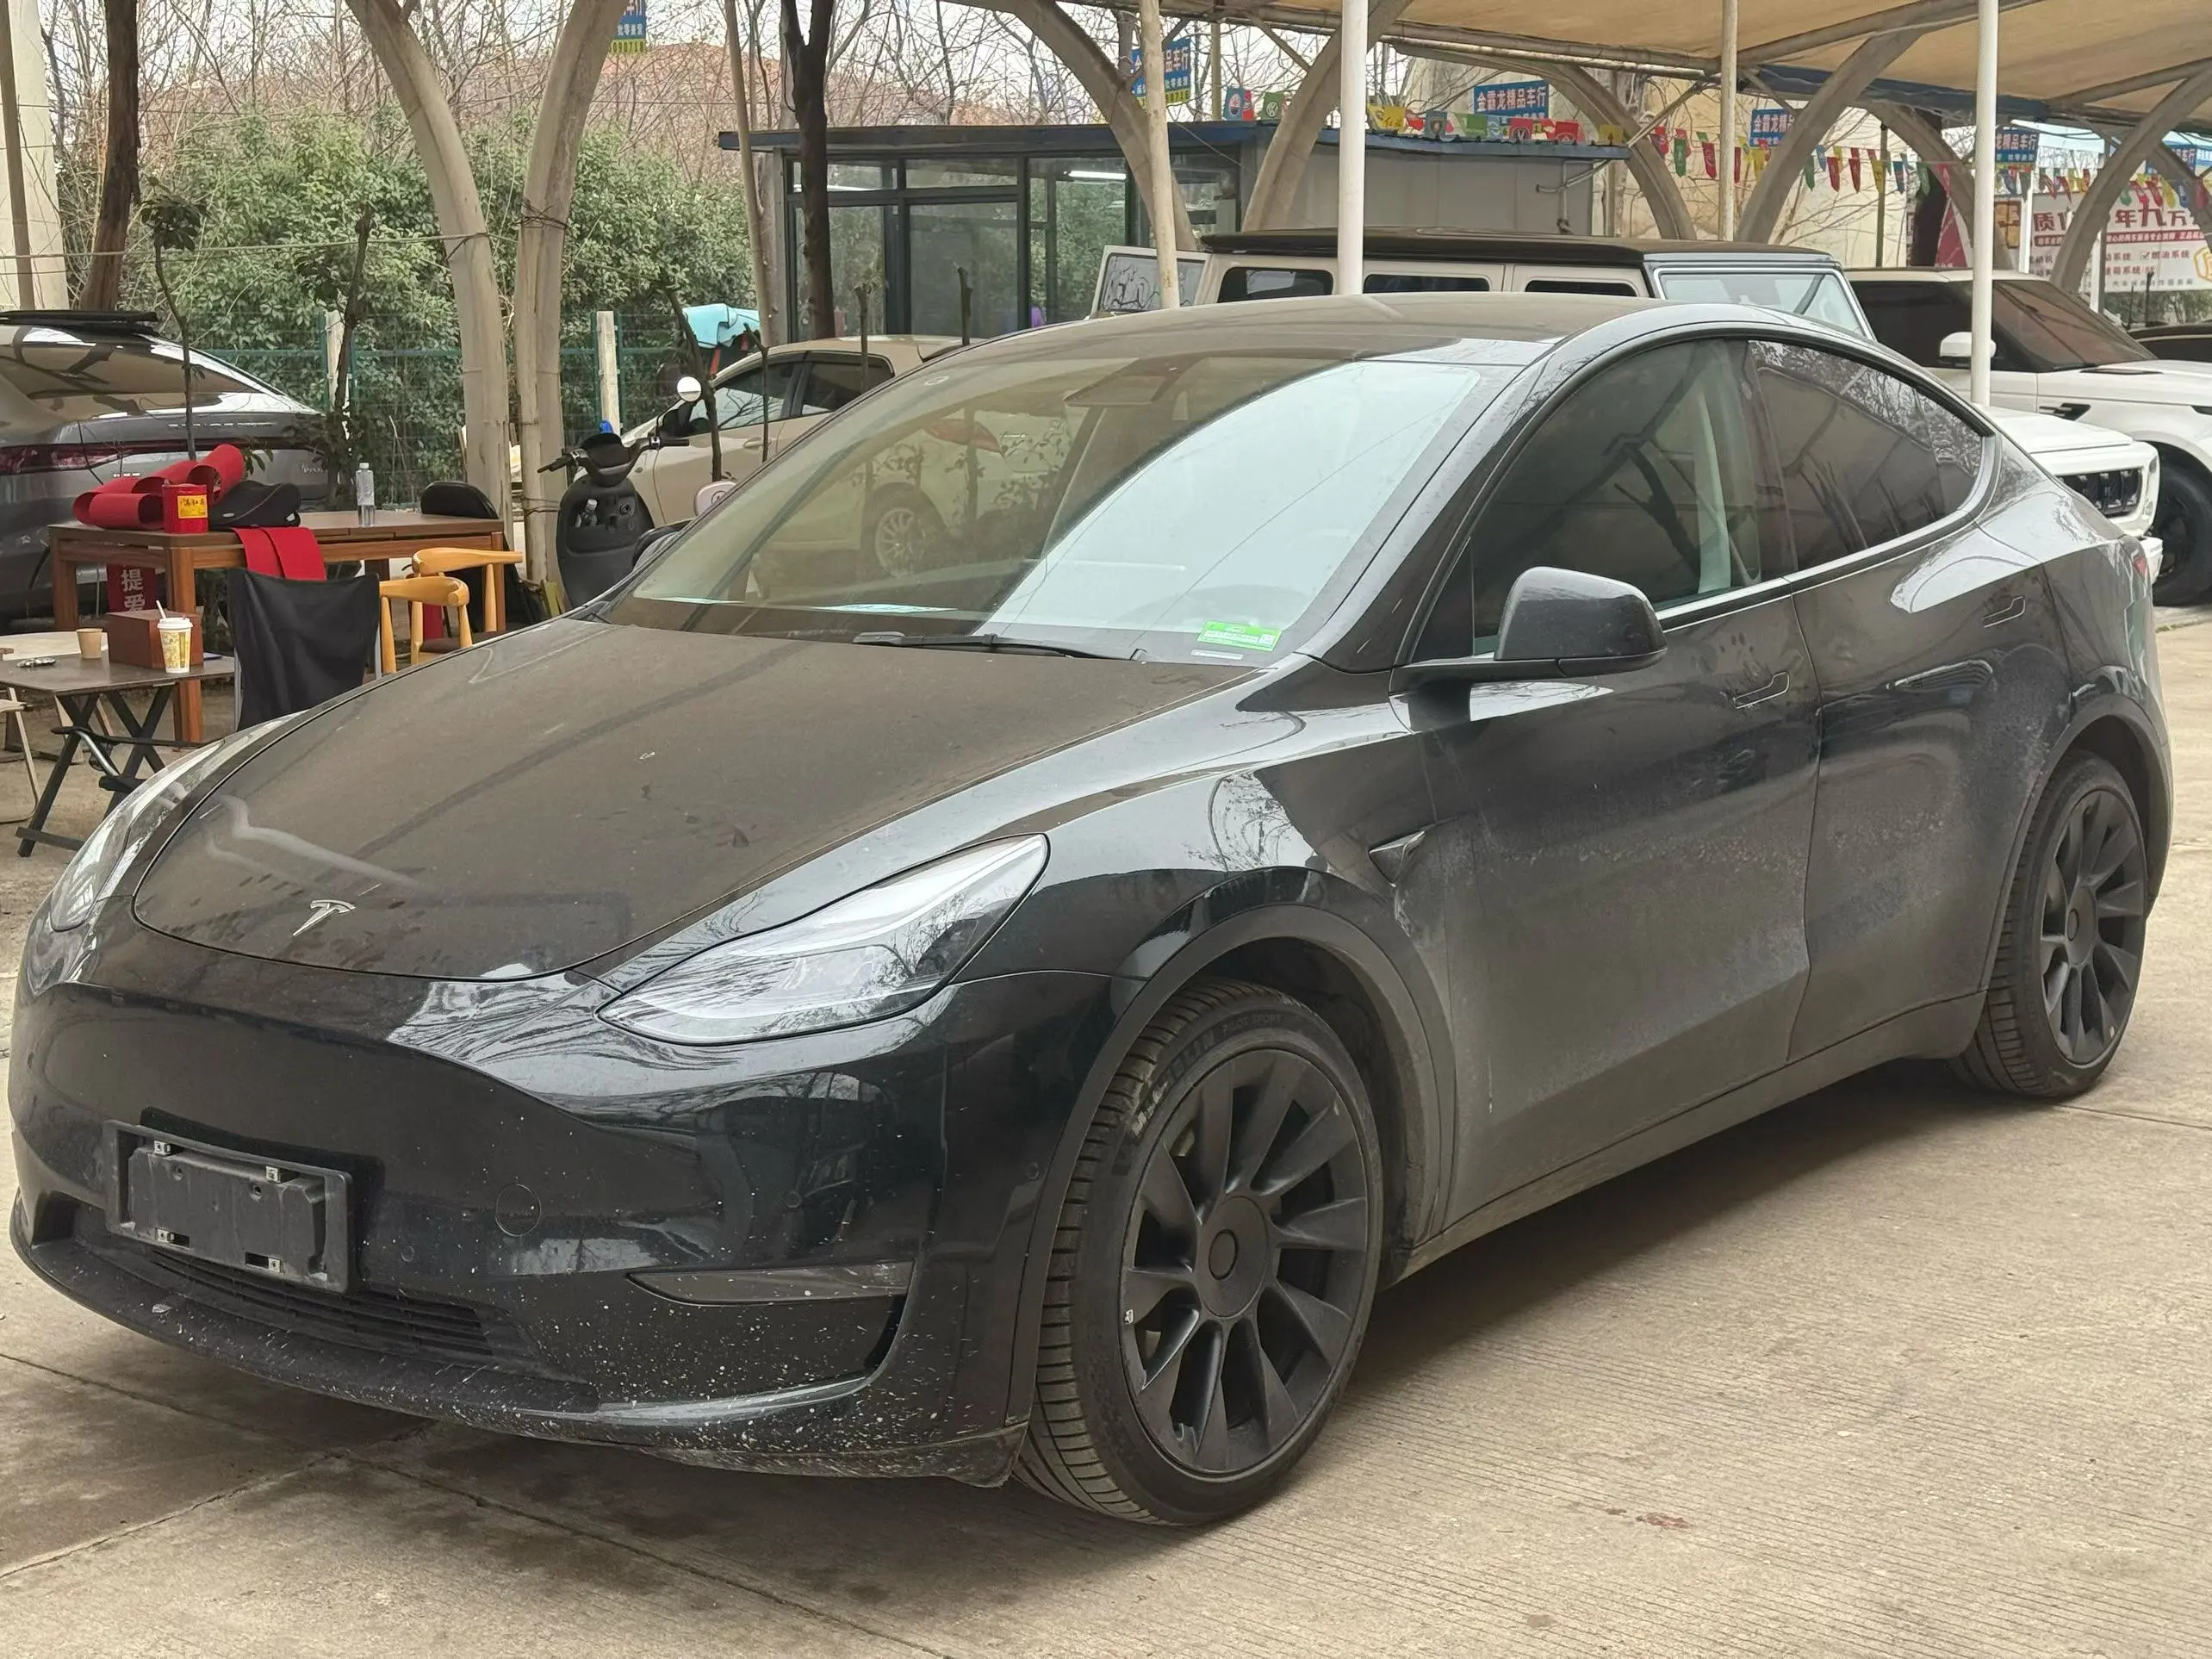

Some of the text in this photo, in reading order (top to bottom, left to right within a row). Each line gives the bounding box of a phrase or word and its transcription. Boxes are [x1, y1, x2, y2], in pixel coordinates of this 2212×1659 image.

[609, 41, 644, 53] 090718
[1476, 87, 1547, 112] 金霸龙精品车行
[1222, 1016, 1249, 1034] PILOT
[1252, 1013, 1282, 1025] SPORT
